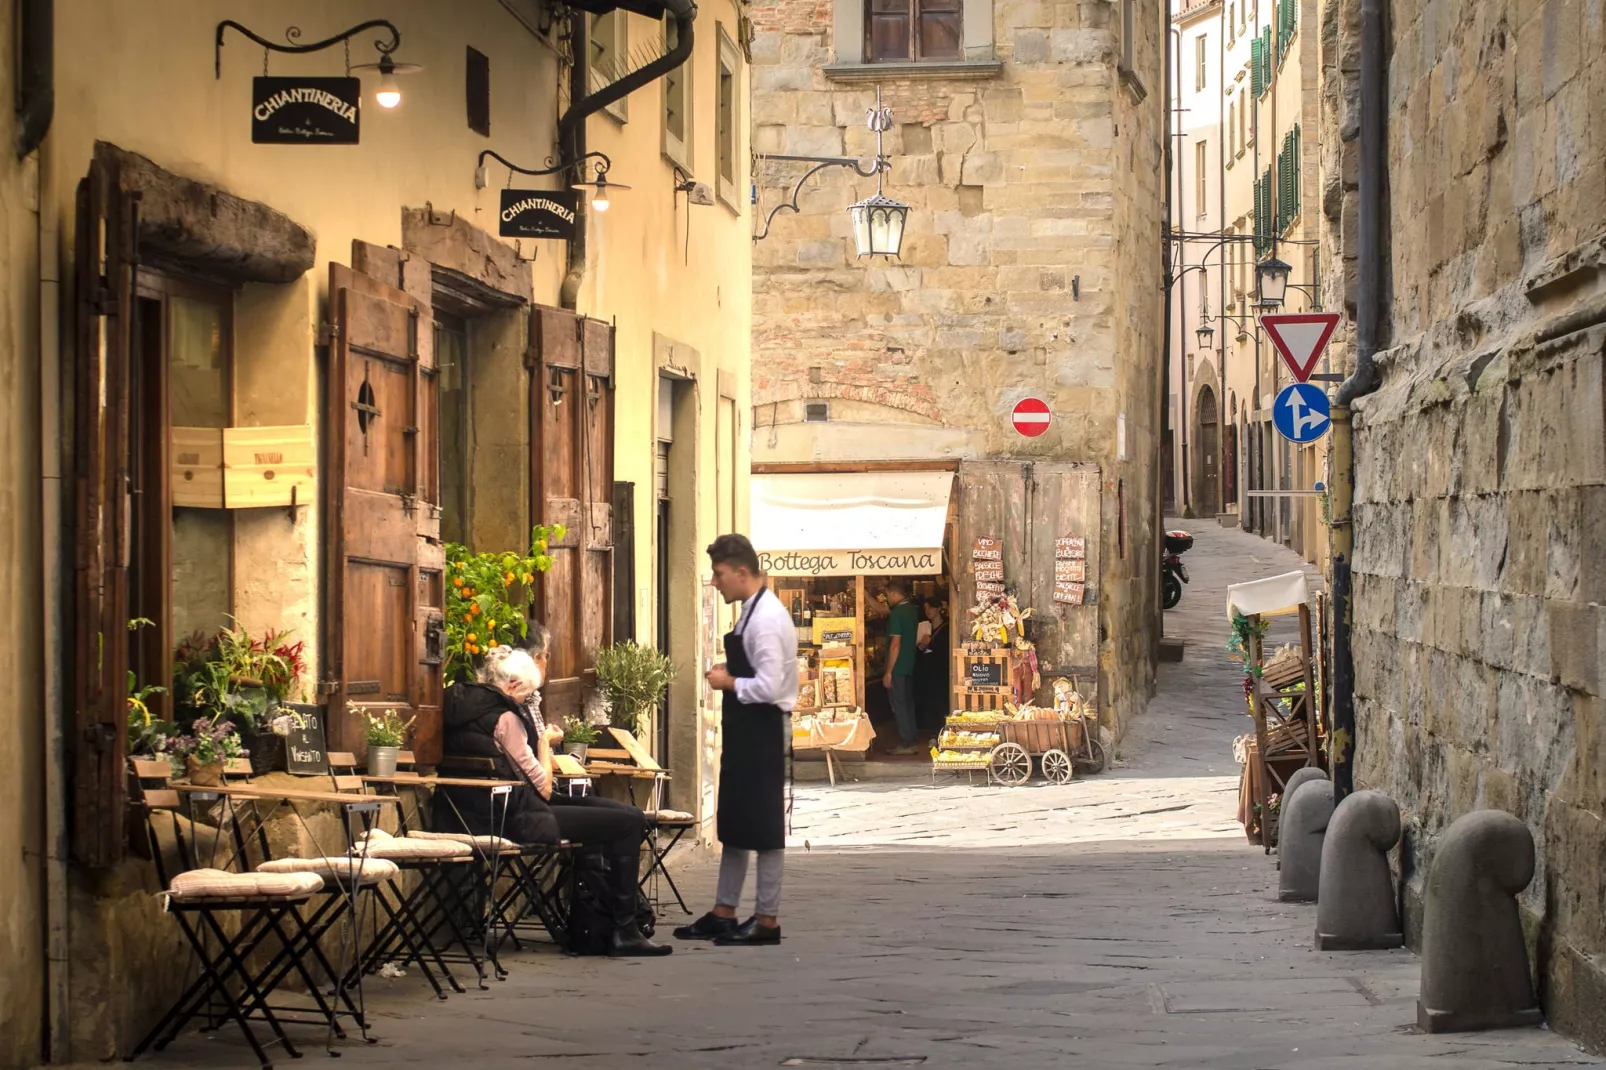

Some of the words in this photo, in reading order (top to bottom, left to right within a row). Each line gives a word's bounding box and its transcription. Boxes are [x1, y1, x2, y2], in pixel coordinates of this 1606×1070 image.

[254, 88, 357, 124] CHIANTINERIA
[502, 198, 575, 224] CHIANTINERIA
[757, 551, 838, 575] Bottega
[847, 549, 935, 570] Toscana
